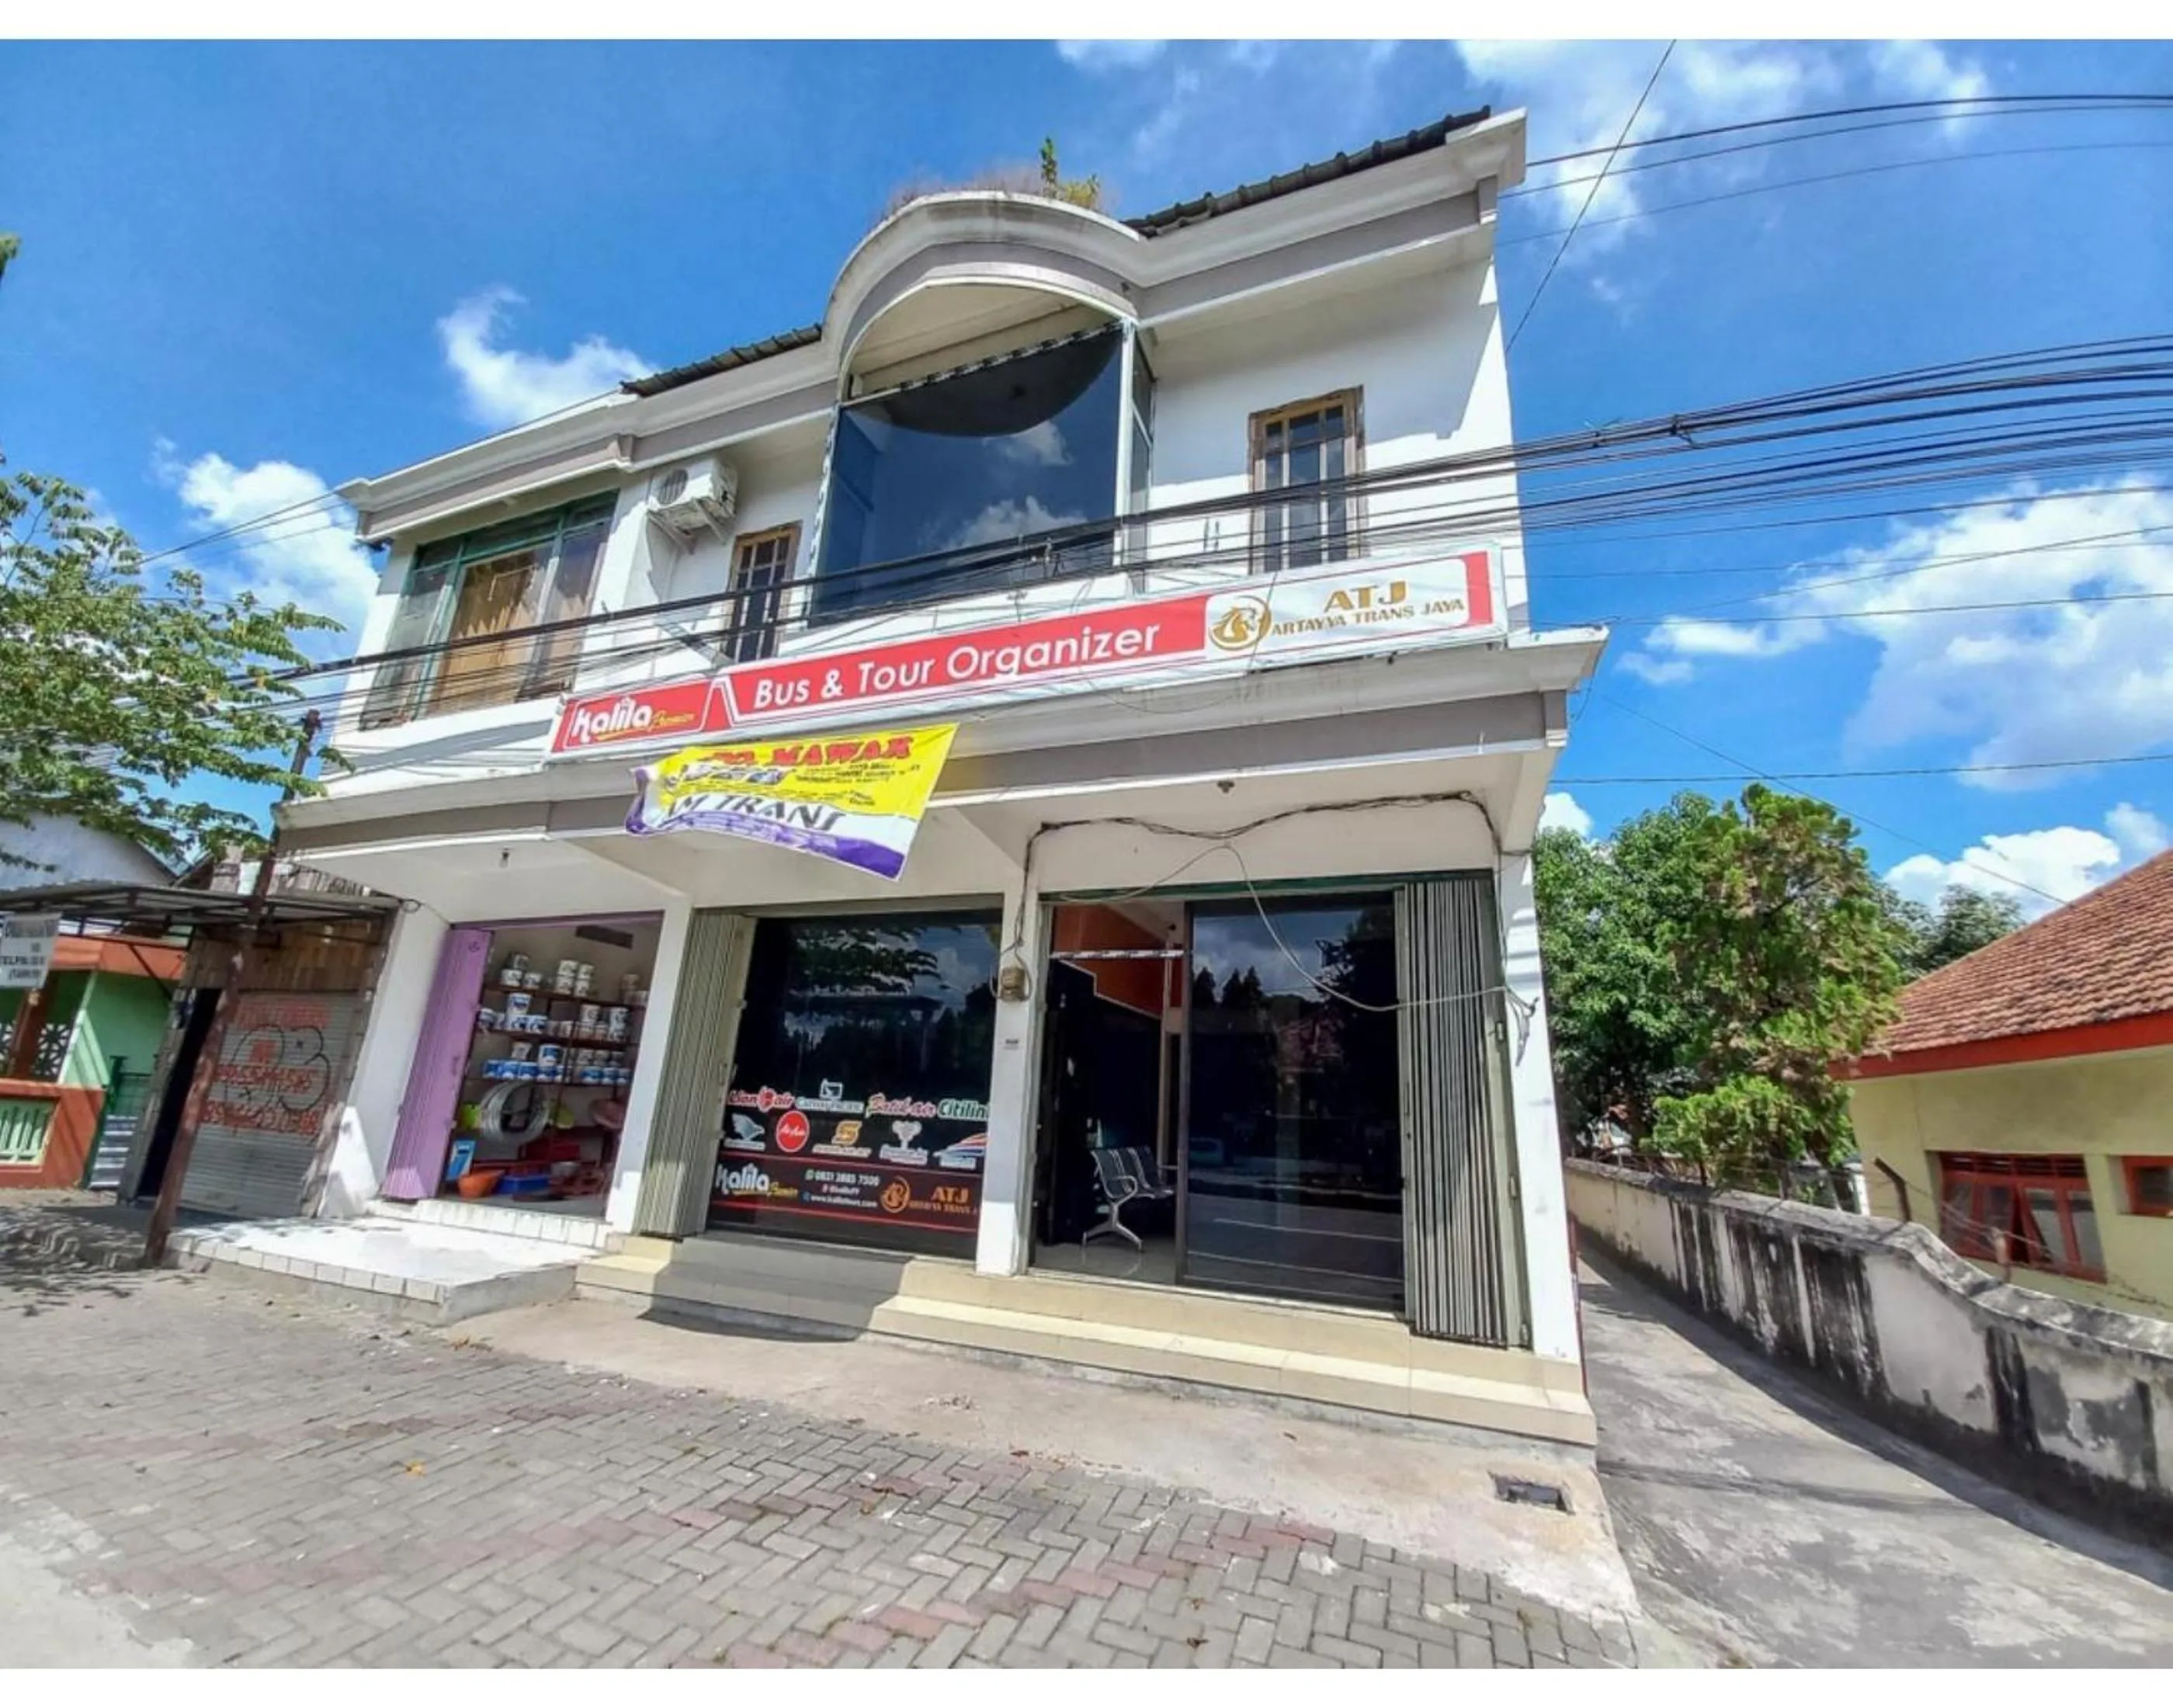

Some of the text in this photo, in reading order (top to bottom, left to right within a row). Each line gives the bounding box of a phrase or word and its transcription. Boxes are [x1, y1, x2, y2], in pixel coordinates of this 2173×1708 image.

[1324, 581, 1407, 613] ATJ
[1353, 606, 1415, 626] TRANS
[1421, 599, 1465, 616] JAYA
[753, 623, 1161, 709] Bus & Tour Organizer
[939, 1099, 989, 1120] Citilin
[932, 1186, 969, 1203] ATJ
